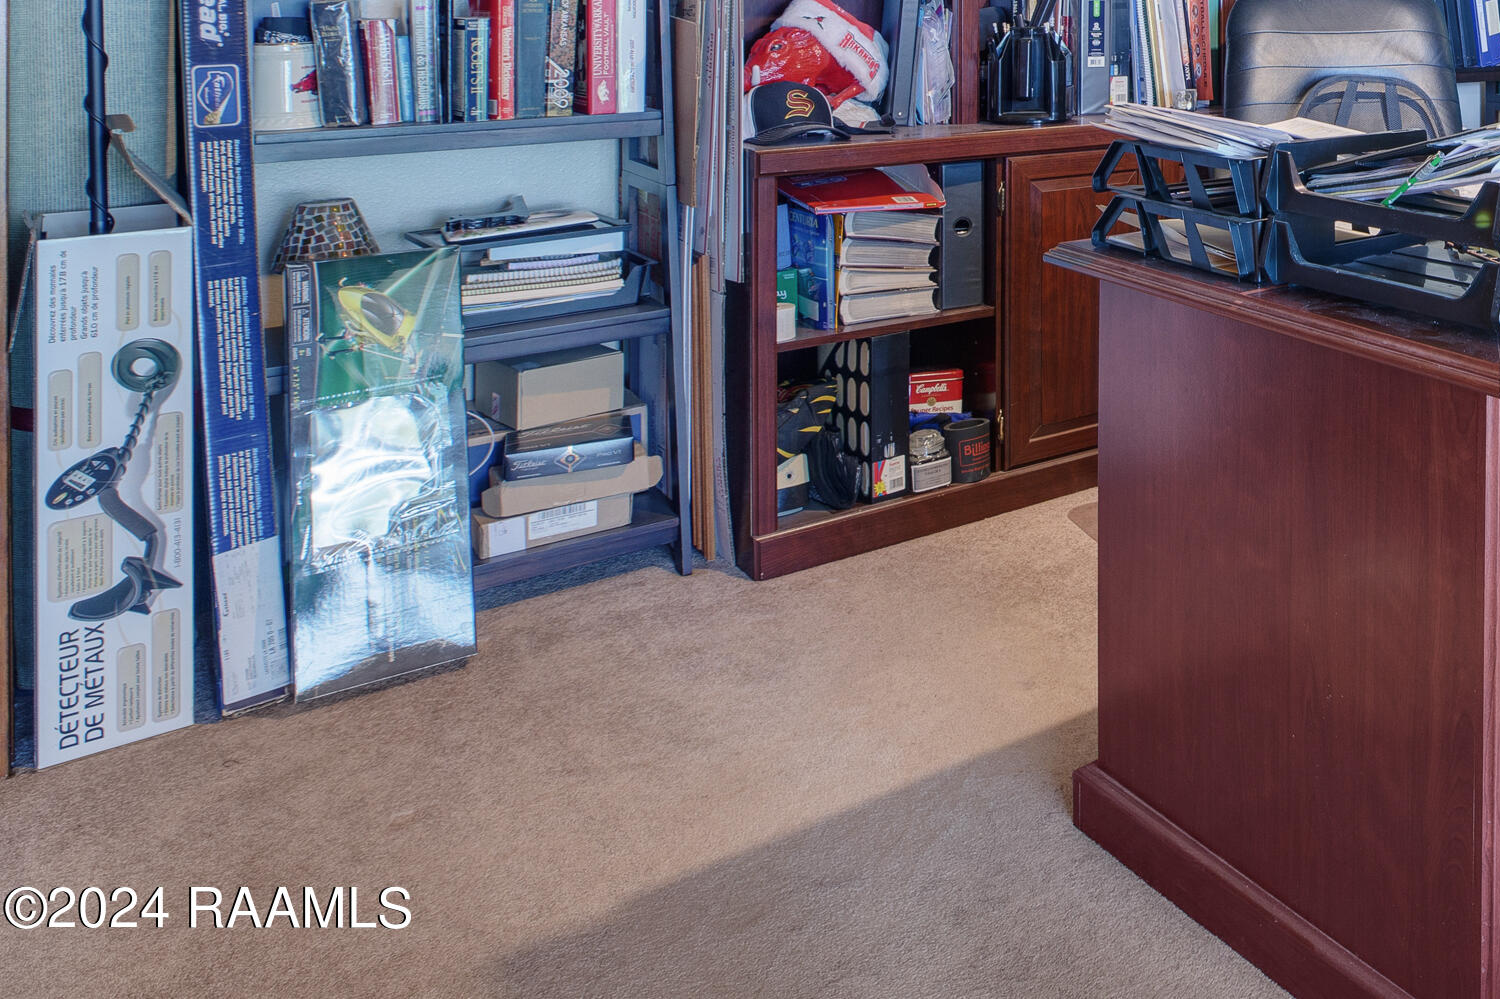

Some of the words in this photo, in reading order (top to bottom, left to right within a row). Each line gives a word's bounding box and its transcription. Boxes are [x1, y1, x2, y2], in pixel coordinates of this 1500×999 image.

[559, 10, 569, 47] ARKANSAS
[470, 37, 483, 86] ROGET'S
[593, 28, 602, 75] UNIVERSITY
[839, 32, 880, 80] ARKANSAS
[501, 62, 512, 100] Dictionary
[785, 89, 815, 119] S
[90, 265, 100, 300] profondeur
[69, 305, 77, 340] profondeur
[915, 383, 948, 395] Campbell's
[80, 622, 104, 709] MÉTAUX
[53, 628, 80, 750] DÉTECTEUR
[83, 712, 104, 743] DE
